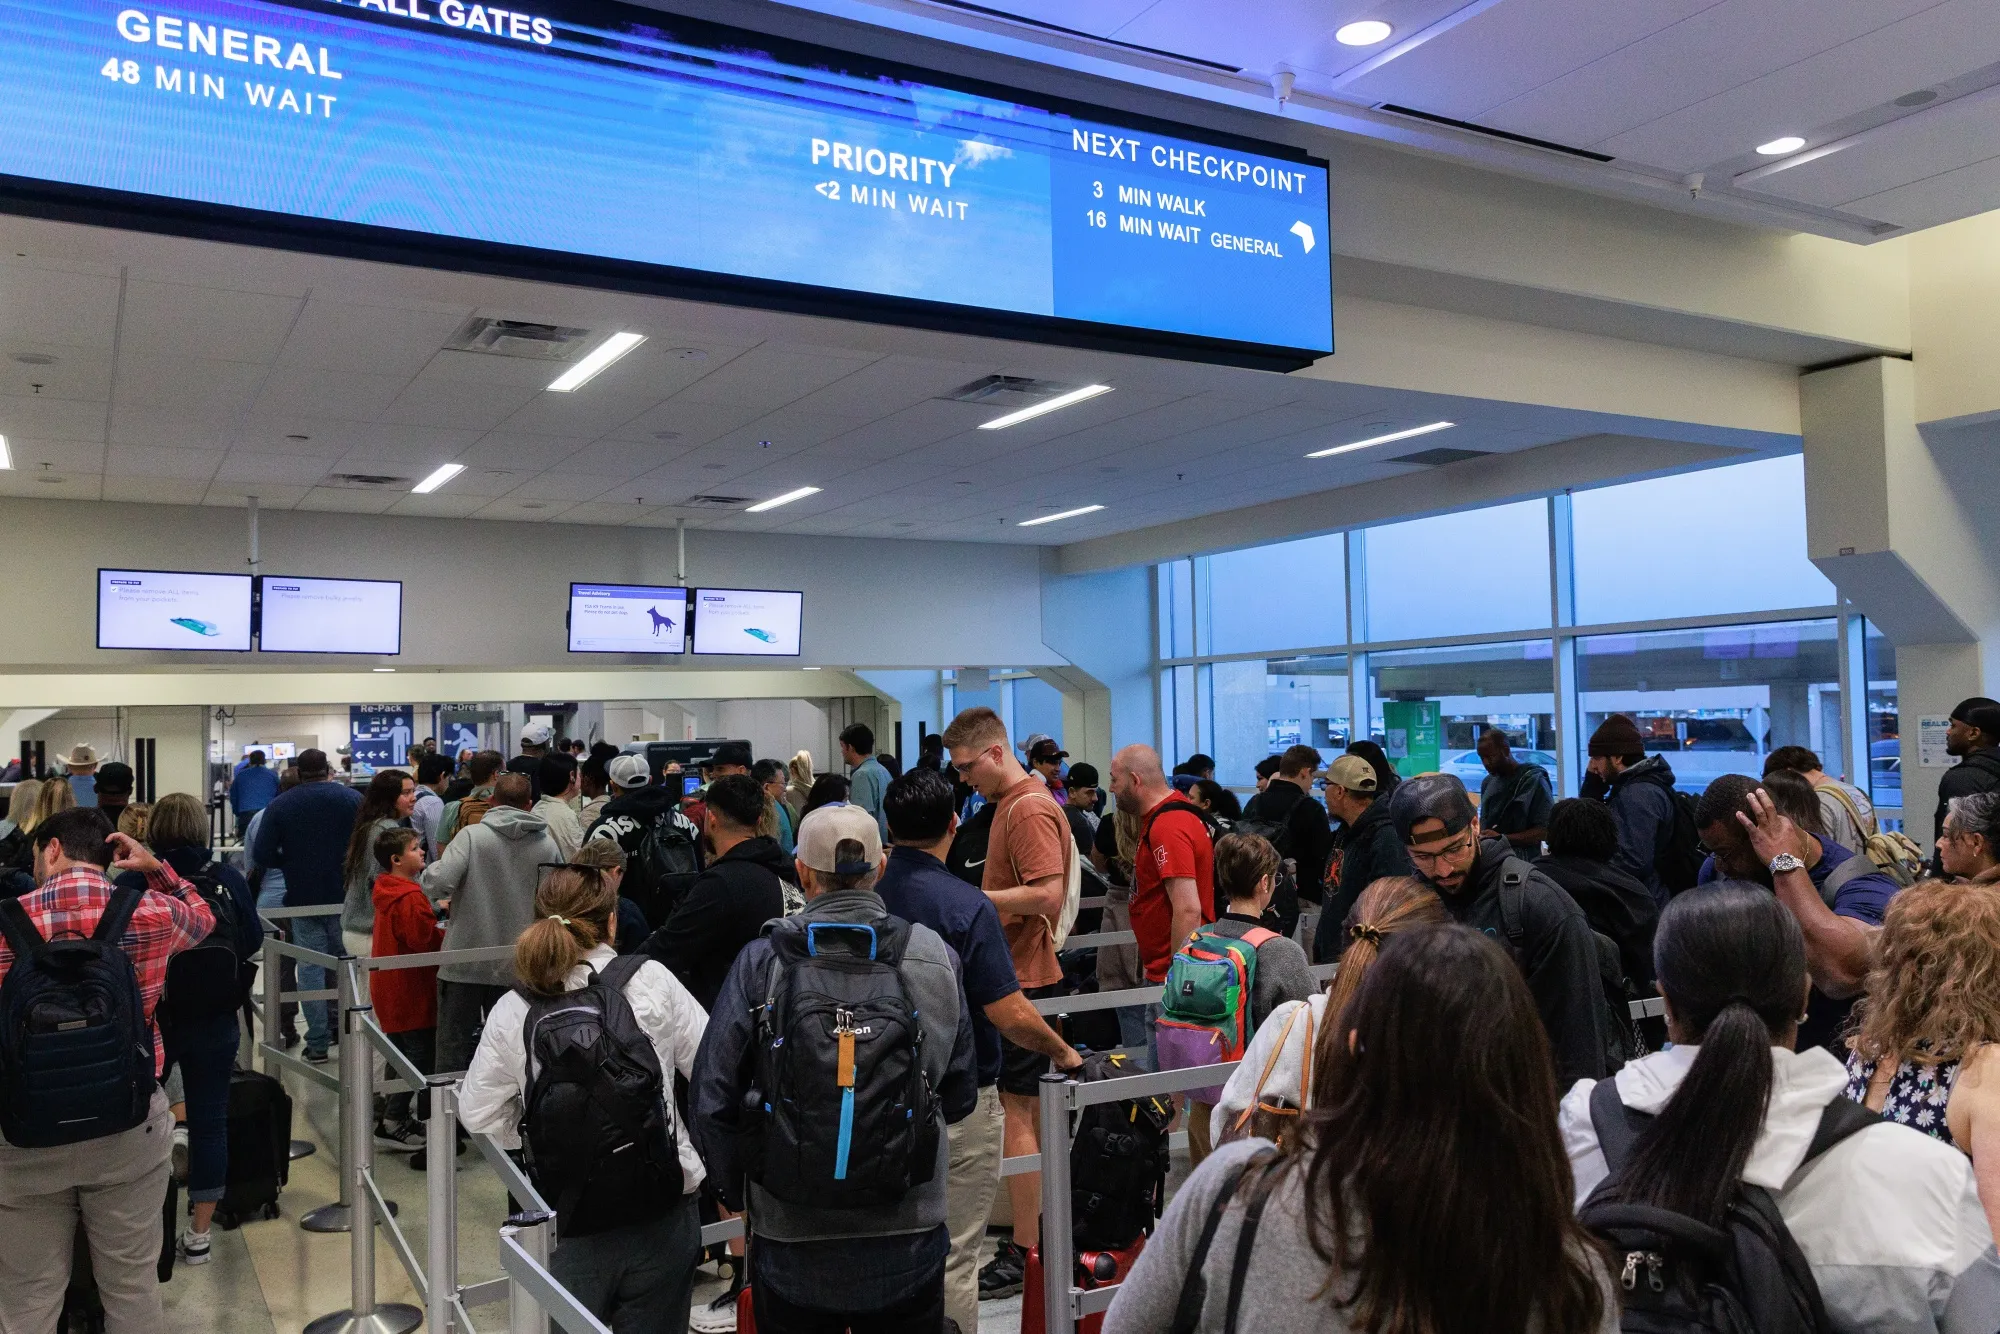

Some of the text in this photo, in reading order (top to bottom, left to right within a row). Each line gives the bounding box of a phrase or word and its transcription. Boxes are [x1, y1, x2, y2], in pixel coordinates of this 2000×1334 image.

[117, 9, 343, 80] GENERAL
[440, 0, 553, 45] GATES
[101, 57, 337, 118] 48 MIN WAIT
[811, 138, 957, 188] PRIORITY
[1073, 128, 1307, 194] NEXT CHECKPOINT
[815, 180, 969, 221] <2 MIN WAIT
[1093, 181, 1206, 217] 3 MIN WALK
[1087, 210, 1283, 258] 16 MIN WAIT GENERAL
[360, 703, 402, 713] Re-Pack
[440, 703, 479, 711] Re-Dres
[833, 1024, 871, 1035] Aon
